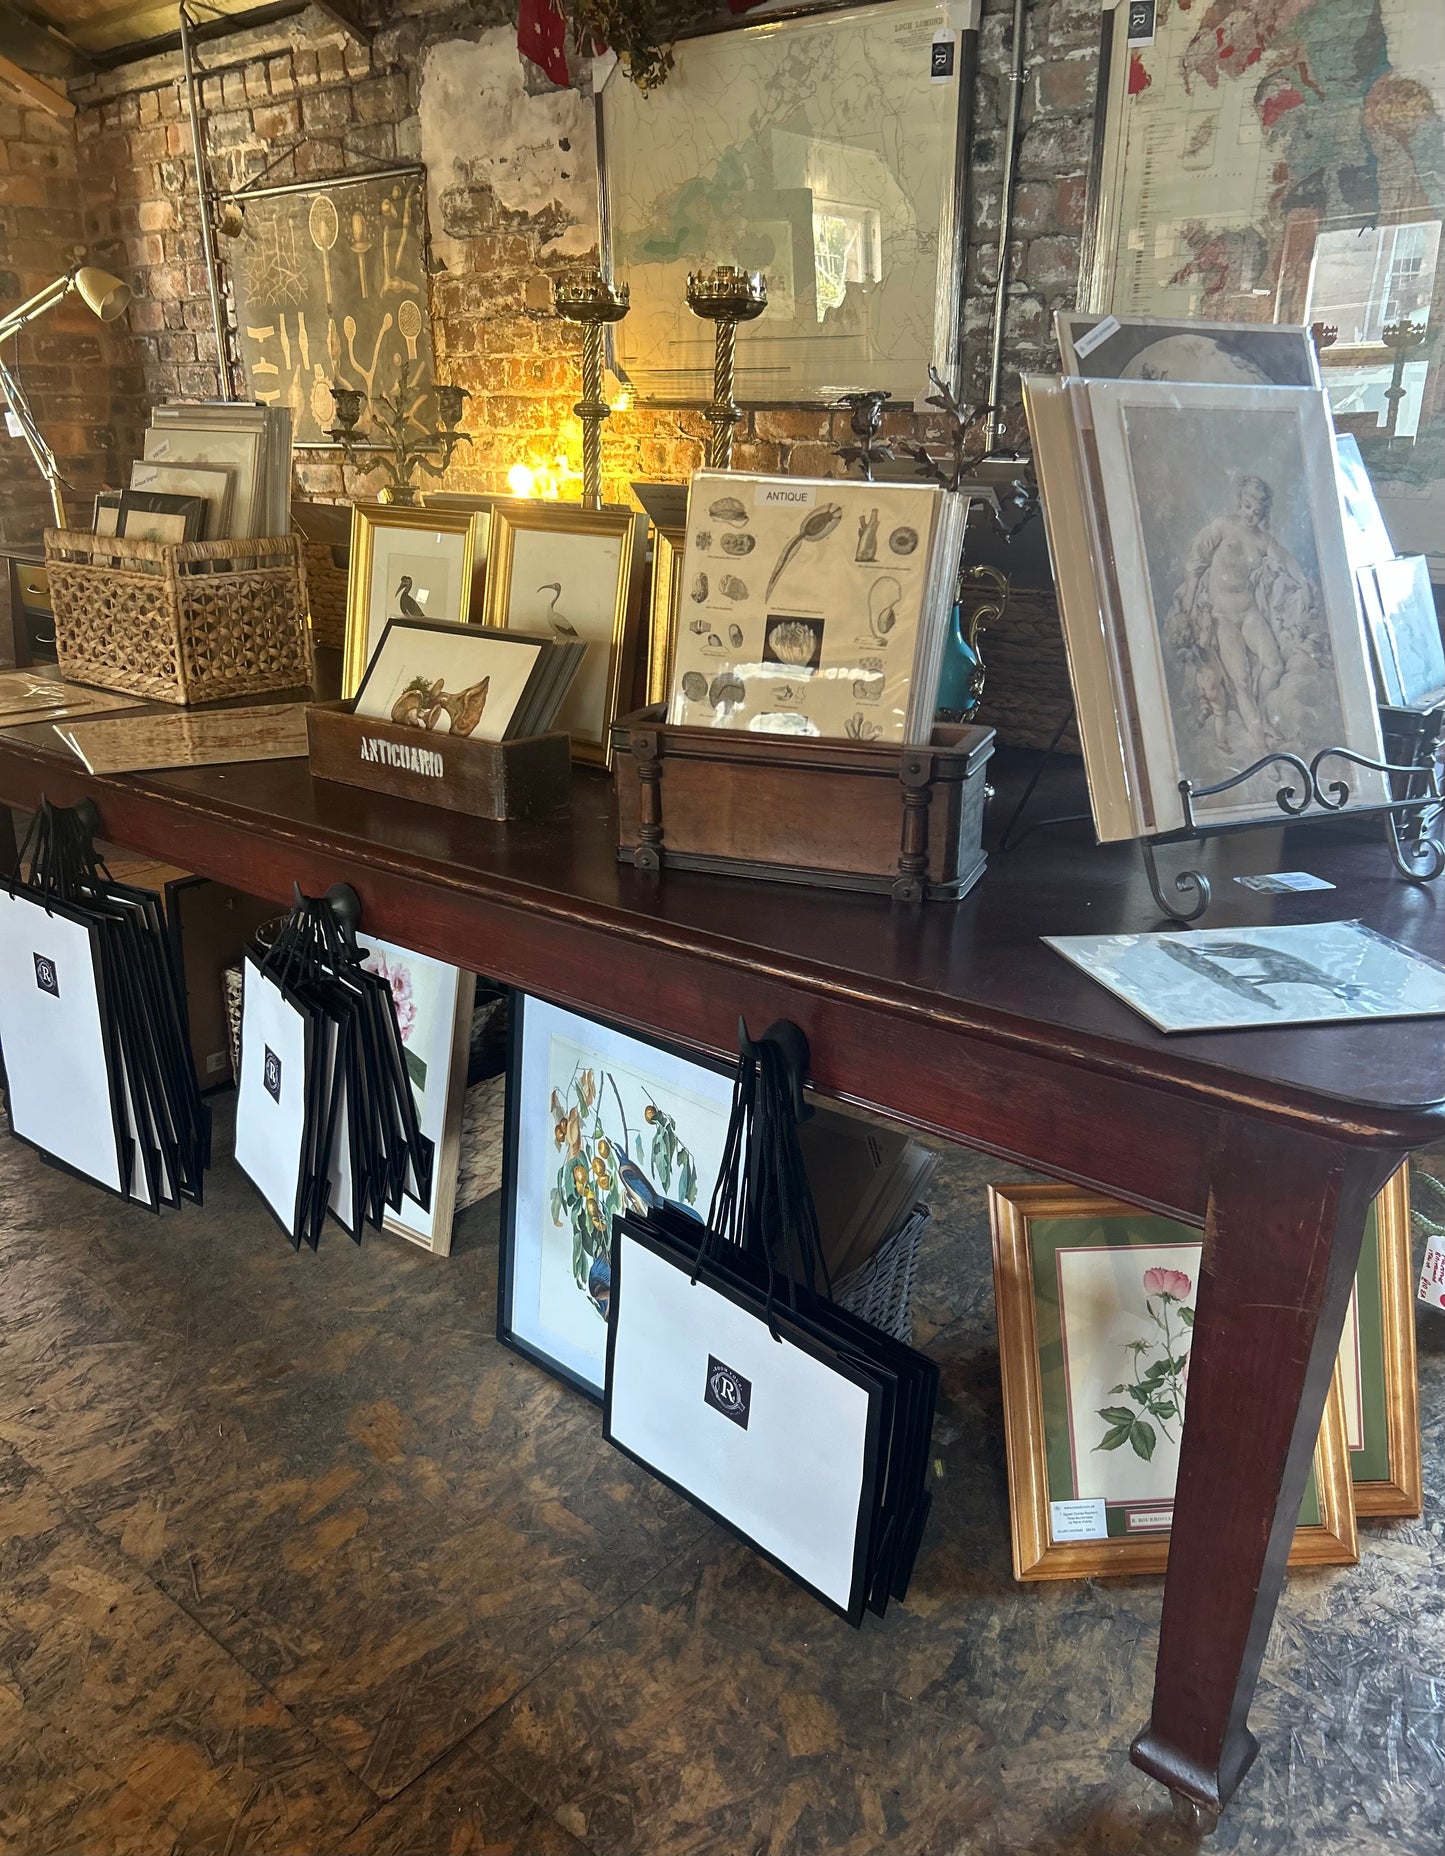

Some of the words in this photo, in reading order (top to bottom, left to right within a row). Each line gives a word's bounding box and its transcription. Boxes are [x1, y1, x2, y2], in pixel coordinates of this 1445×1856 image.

[895, 21, 913, 33] LOCH
[915, 16, 945, 29] LOMOND
[1132, 12, 1146, 26] R
[935, 53, 947, 66] R
[766, 491, 808, 502] ANTIQUE
[361, 736, 444, 778] ANTICUARIO
[41, 965, 52, 983] R
[720, 1376, 736, 1404] R
